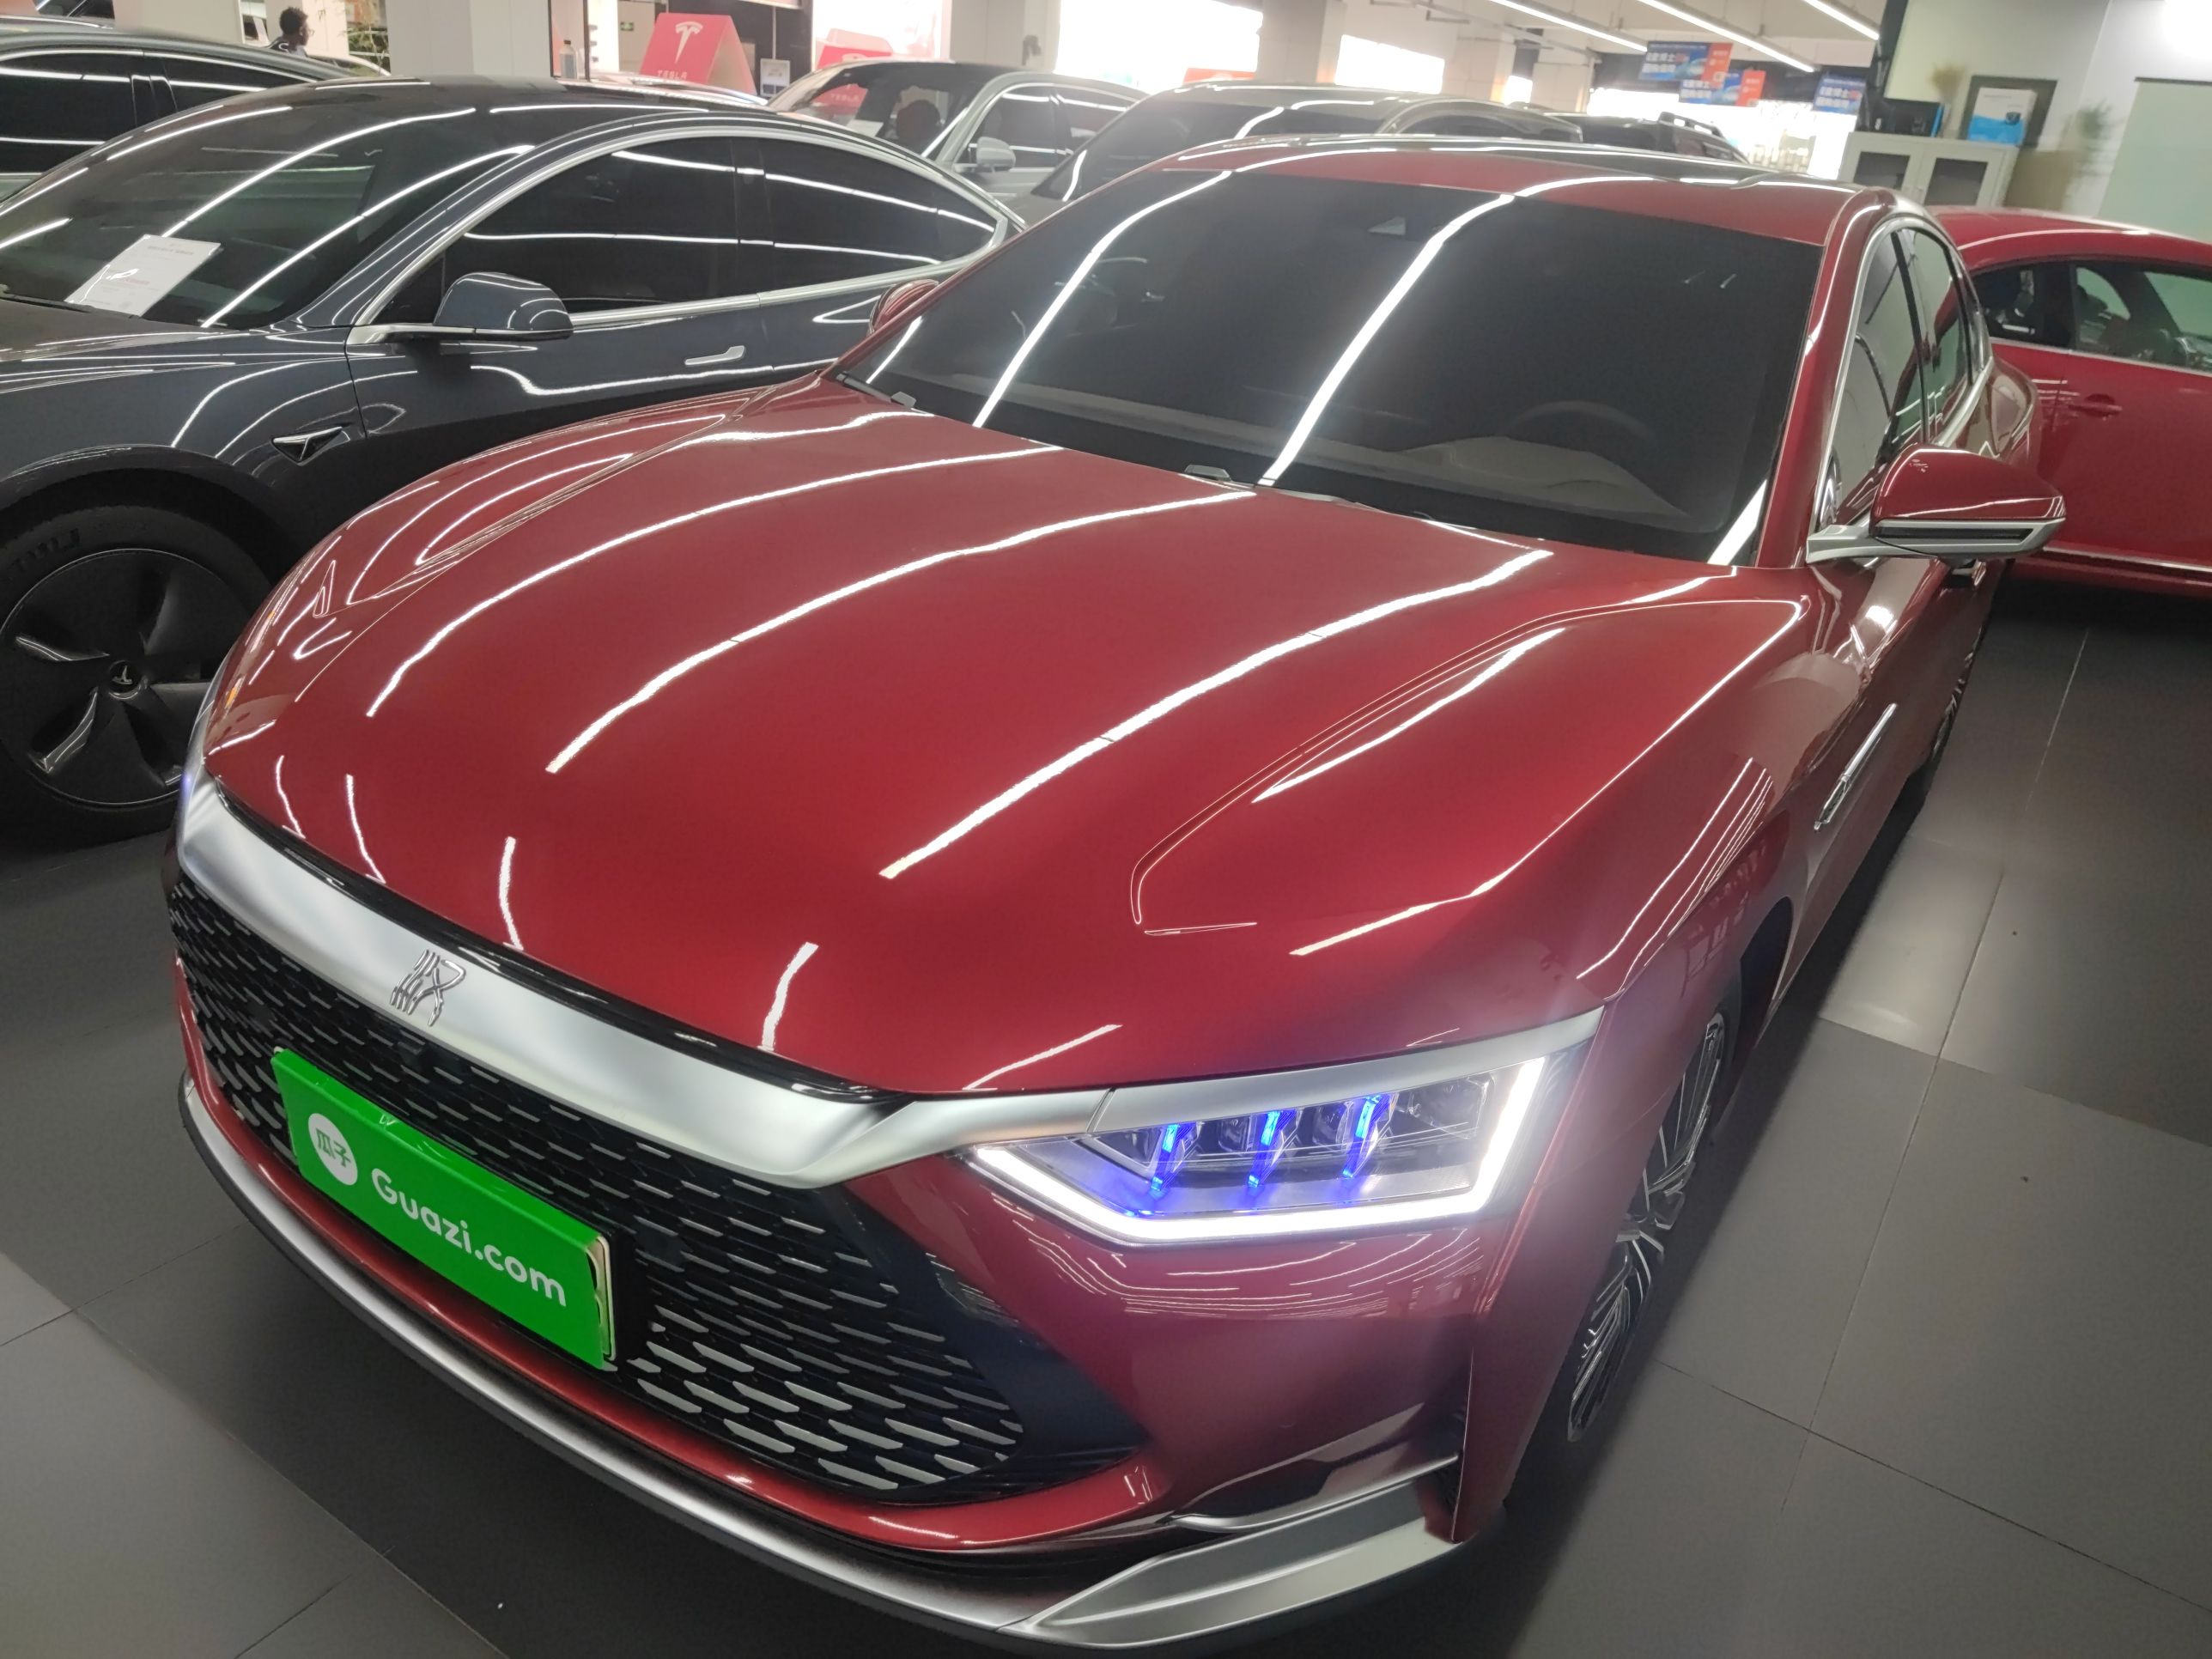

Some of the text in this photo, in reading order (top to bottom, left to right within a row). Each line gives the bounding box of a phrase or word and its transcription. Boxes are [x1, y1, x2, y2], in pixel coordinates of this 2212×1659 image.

[658, 70, 687, 80] TESLA
[316, 1128, 351, 1169] 瓜子
[371, 1168, 567, 1307] Guazi.com
